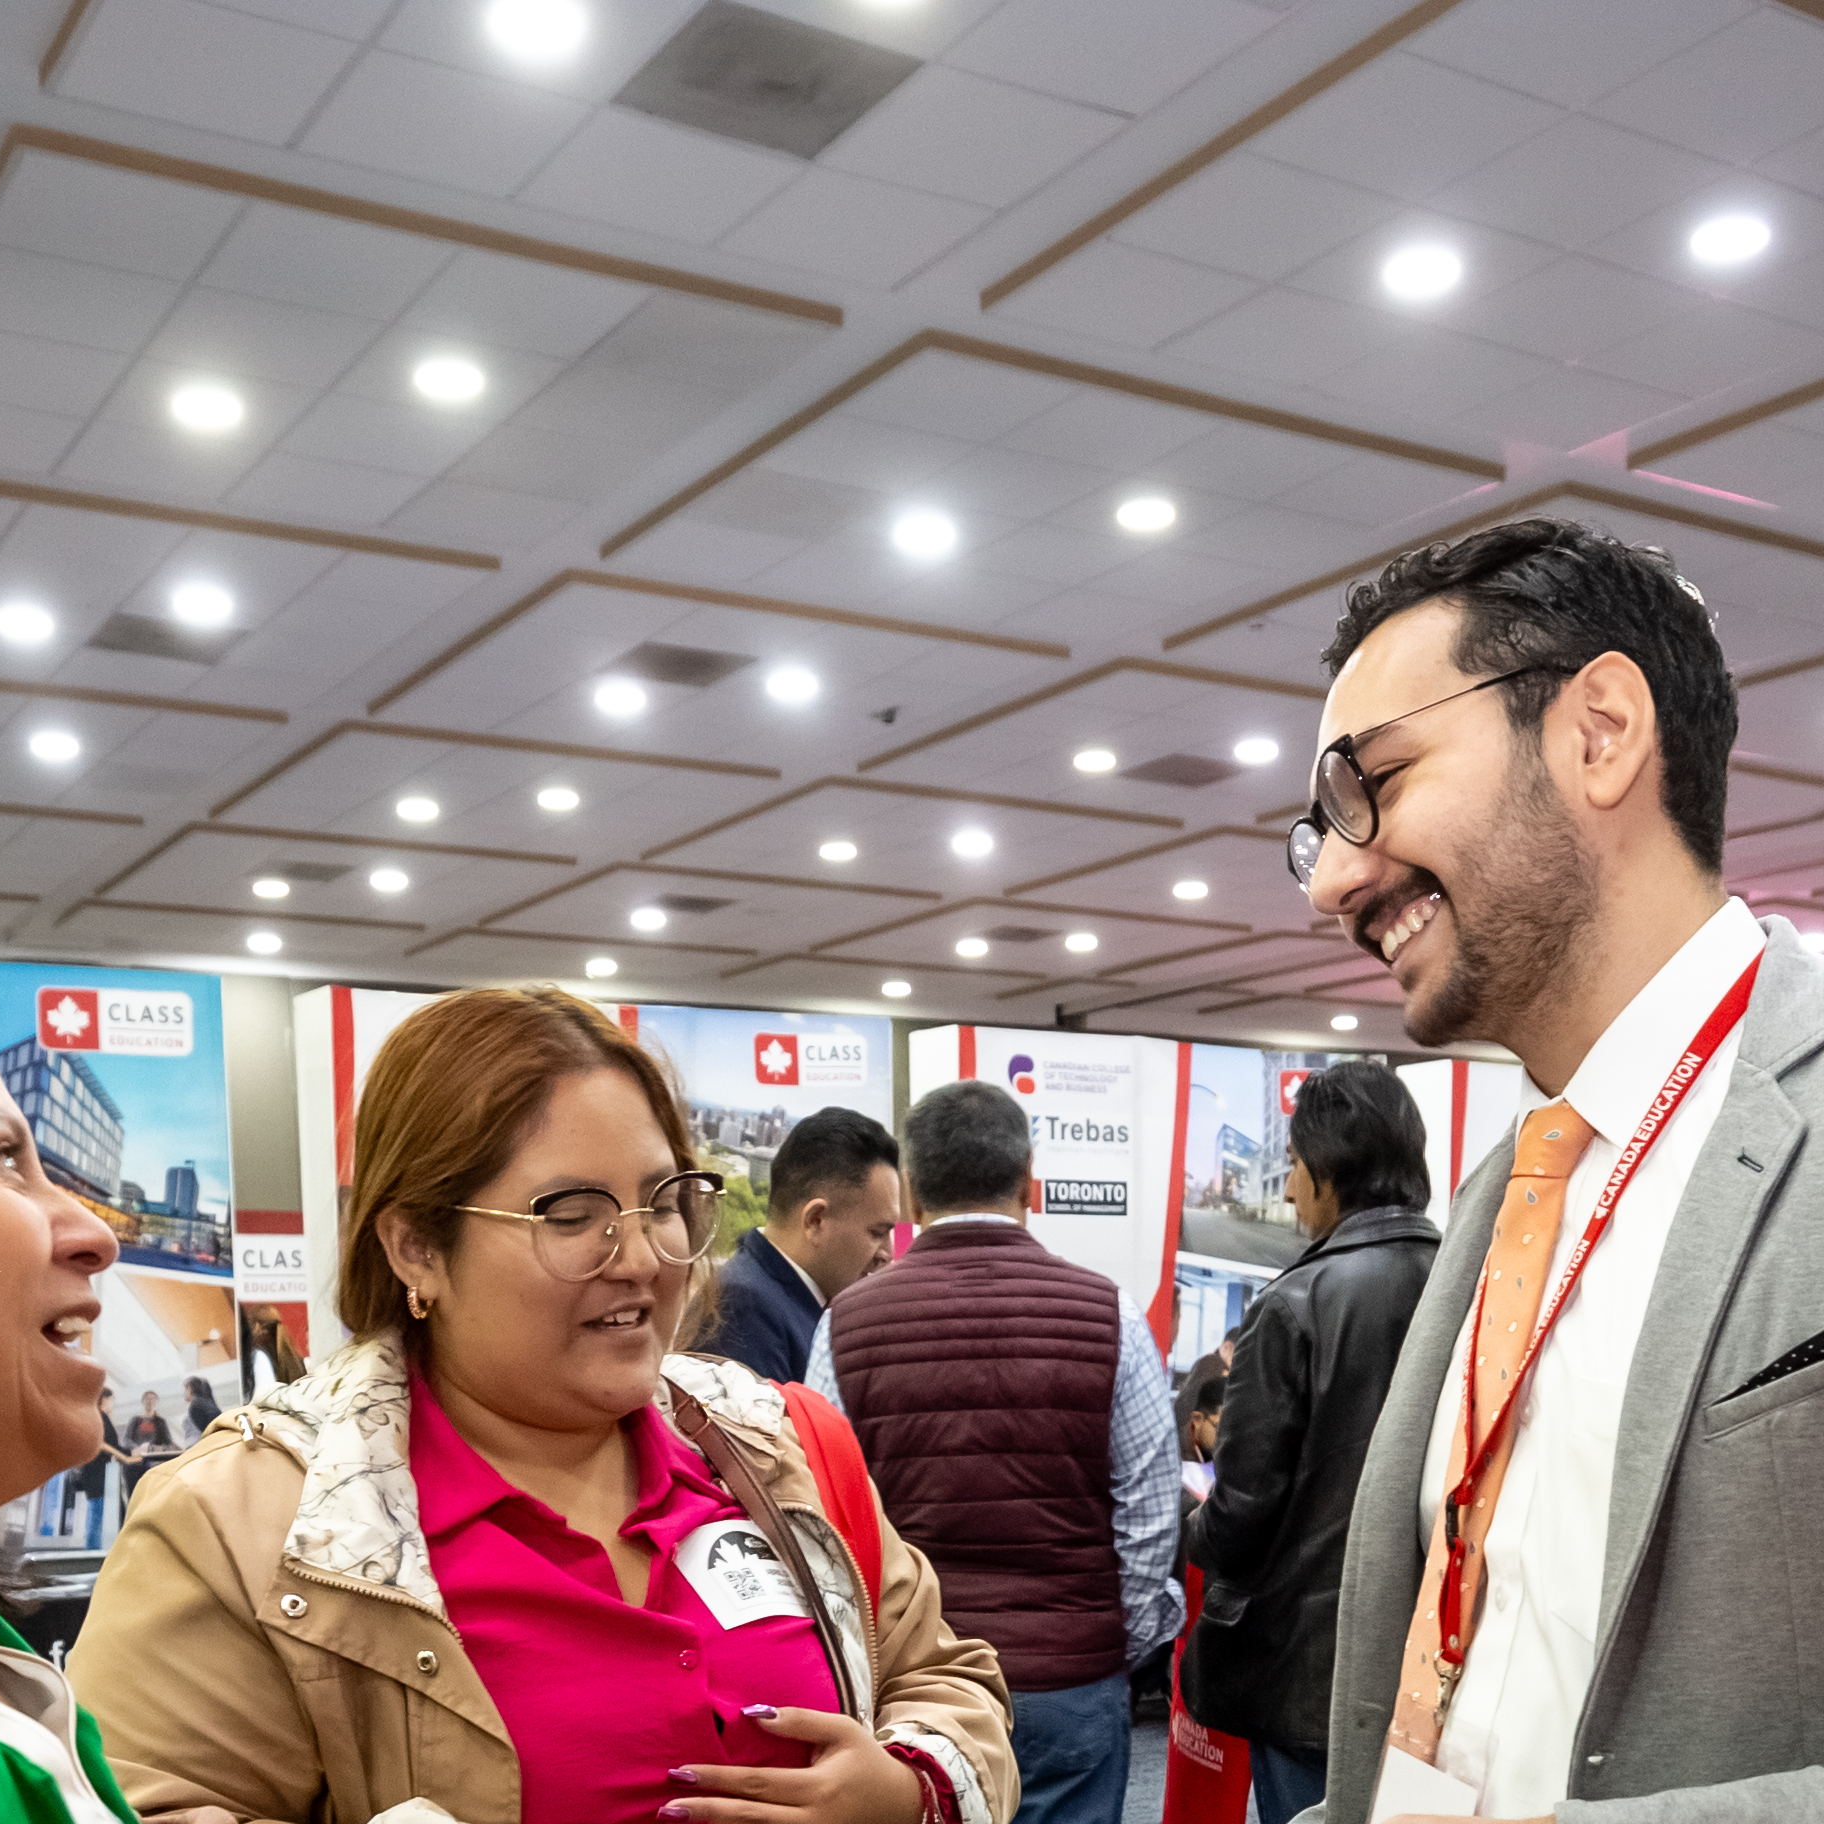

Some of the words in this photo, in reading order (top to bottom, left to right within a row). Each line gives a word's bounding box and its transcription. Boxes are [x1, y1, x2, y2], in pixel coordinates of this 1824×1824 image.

[108, 1003, 185, 1026] CLASS
[108, 1034, 184, 1048] EDUCATION
[805, 1044, 862, 1063] CLASS
[805, 1071, 862, 1082] EDUCATION
[1045, 1116, 1129, 1143] Trebas
[1600, 1051, 1703, 1208] CANADAEDUCATION
[1047, 1181, 1126, 1202] TORONTO
[242, 1247, 303, 1269] CLAS
[243, 1281, 307, 1294] EDUCATIO
